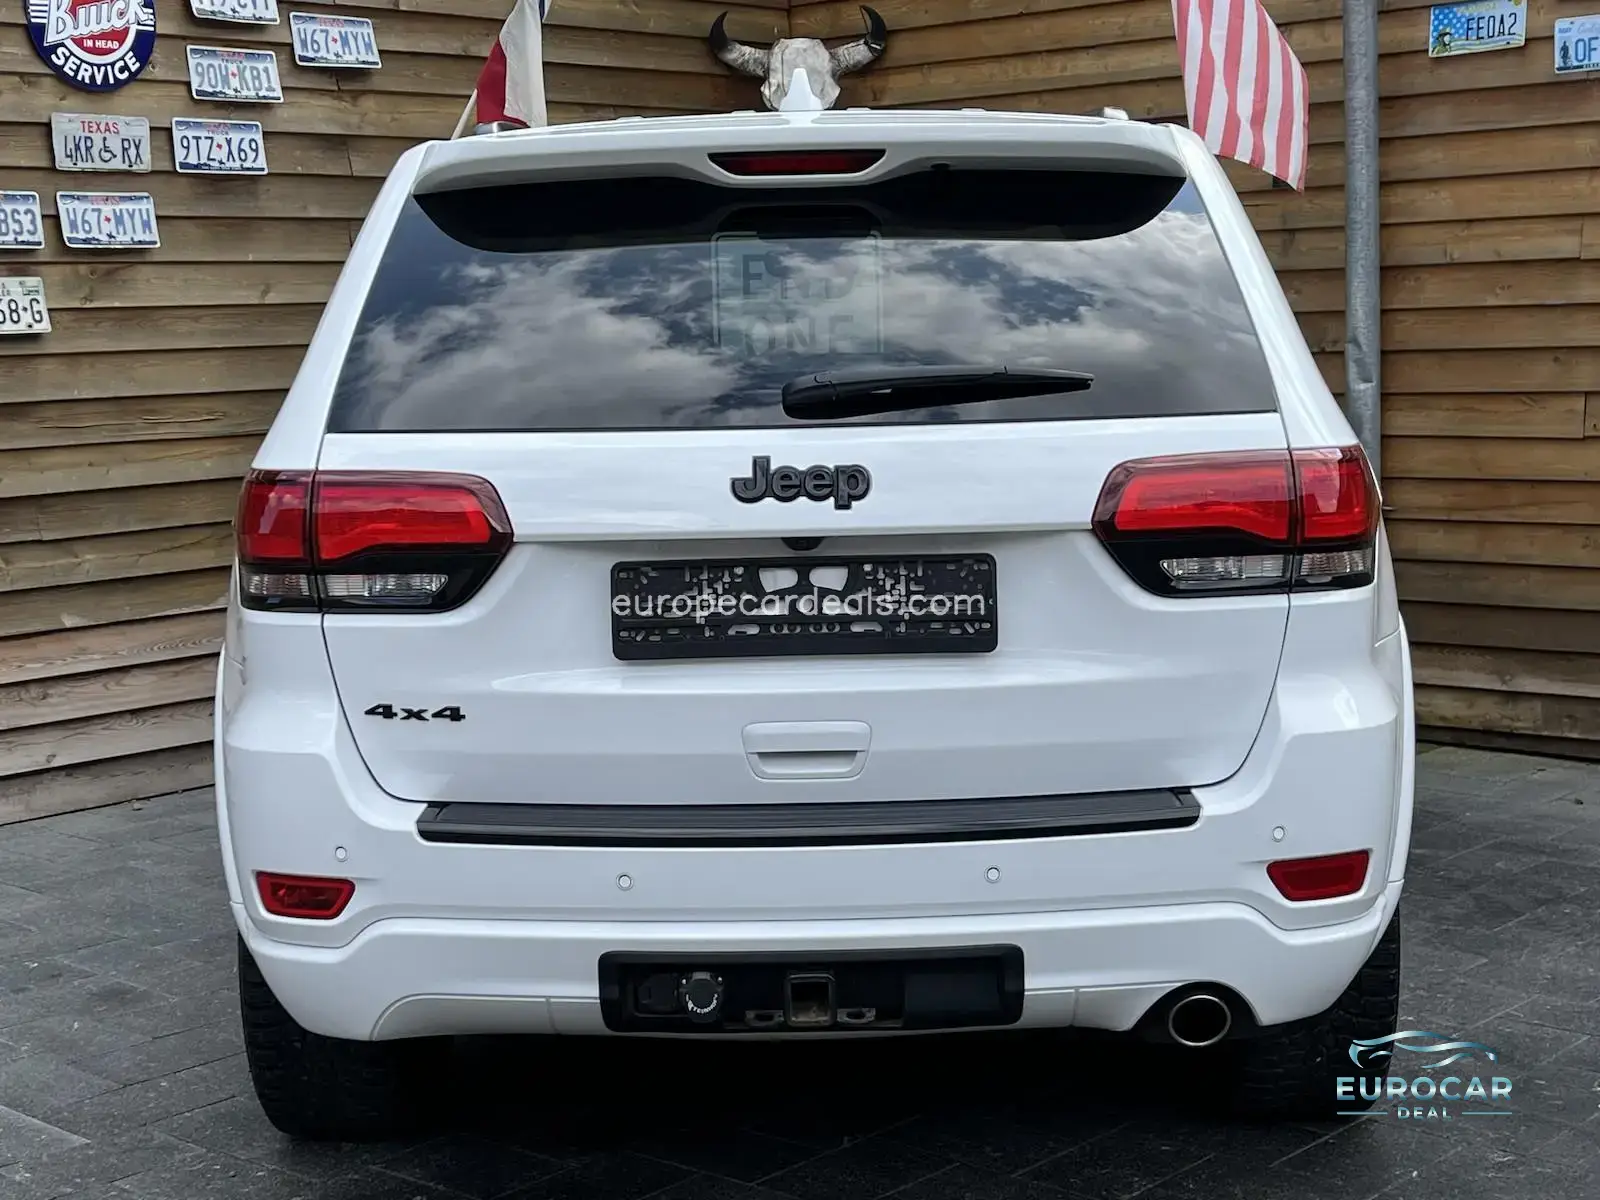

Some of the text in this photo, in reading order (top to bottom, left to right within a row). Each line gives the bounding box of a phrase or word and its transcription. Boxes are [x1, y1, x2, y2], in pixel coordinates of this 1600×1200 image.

[83, 39, 120, 49] IN HEAD
[50, 46, 141, 85] SERVICE
[80, 120, 120, 135] TEXAS
[64, 135, 144, 165] 4KR RX
[180, 134, 259, 165] 9TZ X69
[730, 455, 872, 510] Jeep
[364, 703, 466, 722] 4x4
